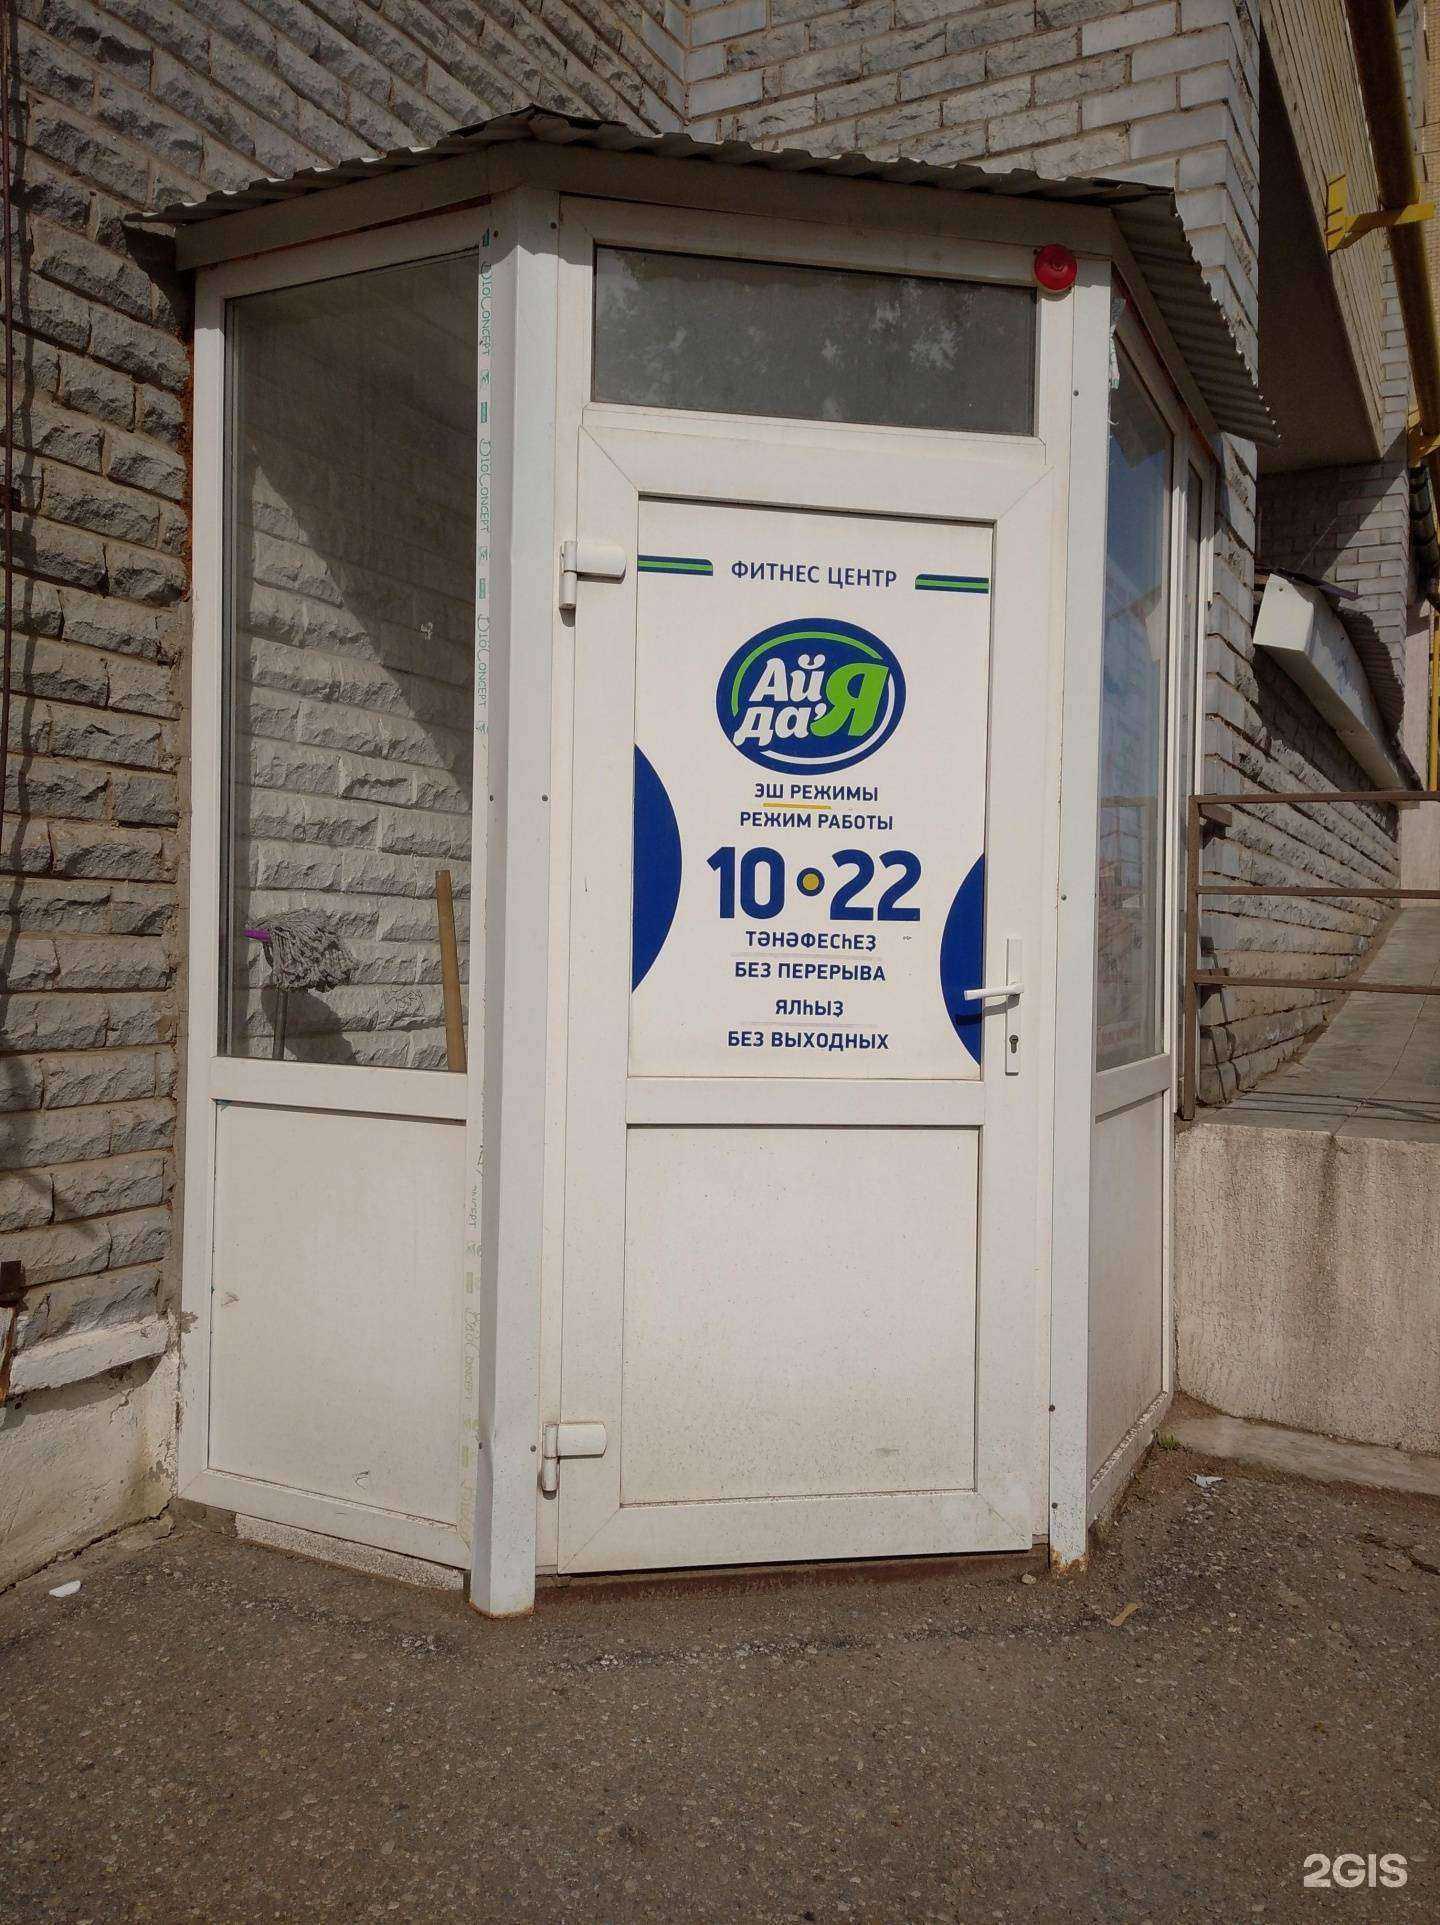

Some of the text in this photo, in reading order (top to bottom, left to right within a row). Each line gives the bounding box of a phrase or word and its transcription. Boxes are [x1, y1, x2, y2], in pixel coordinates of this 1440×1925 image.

[731, 560, 898, 590] ФИТНЕС ЦЕНТР
[754, 782, 878, 802] ЭШ РЕЖИМЫ
[740, 811, 893, 831] РЕЖИМ РАБОТЫ
[734, 961, 886, 982] БЕЗ ПЕРЕРЫВА
[727, 1030, 889, 1052] БЕЗ ВЫХОДНЫХ
